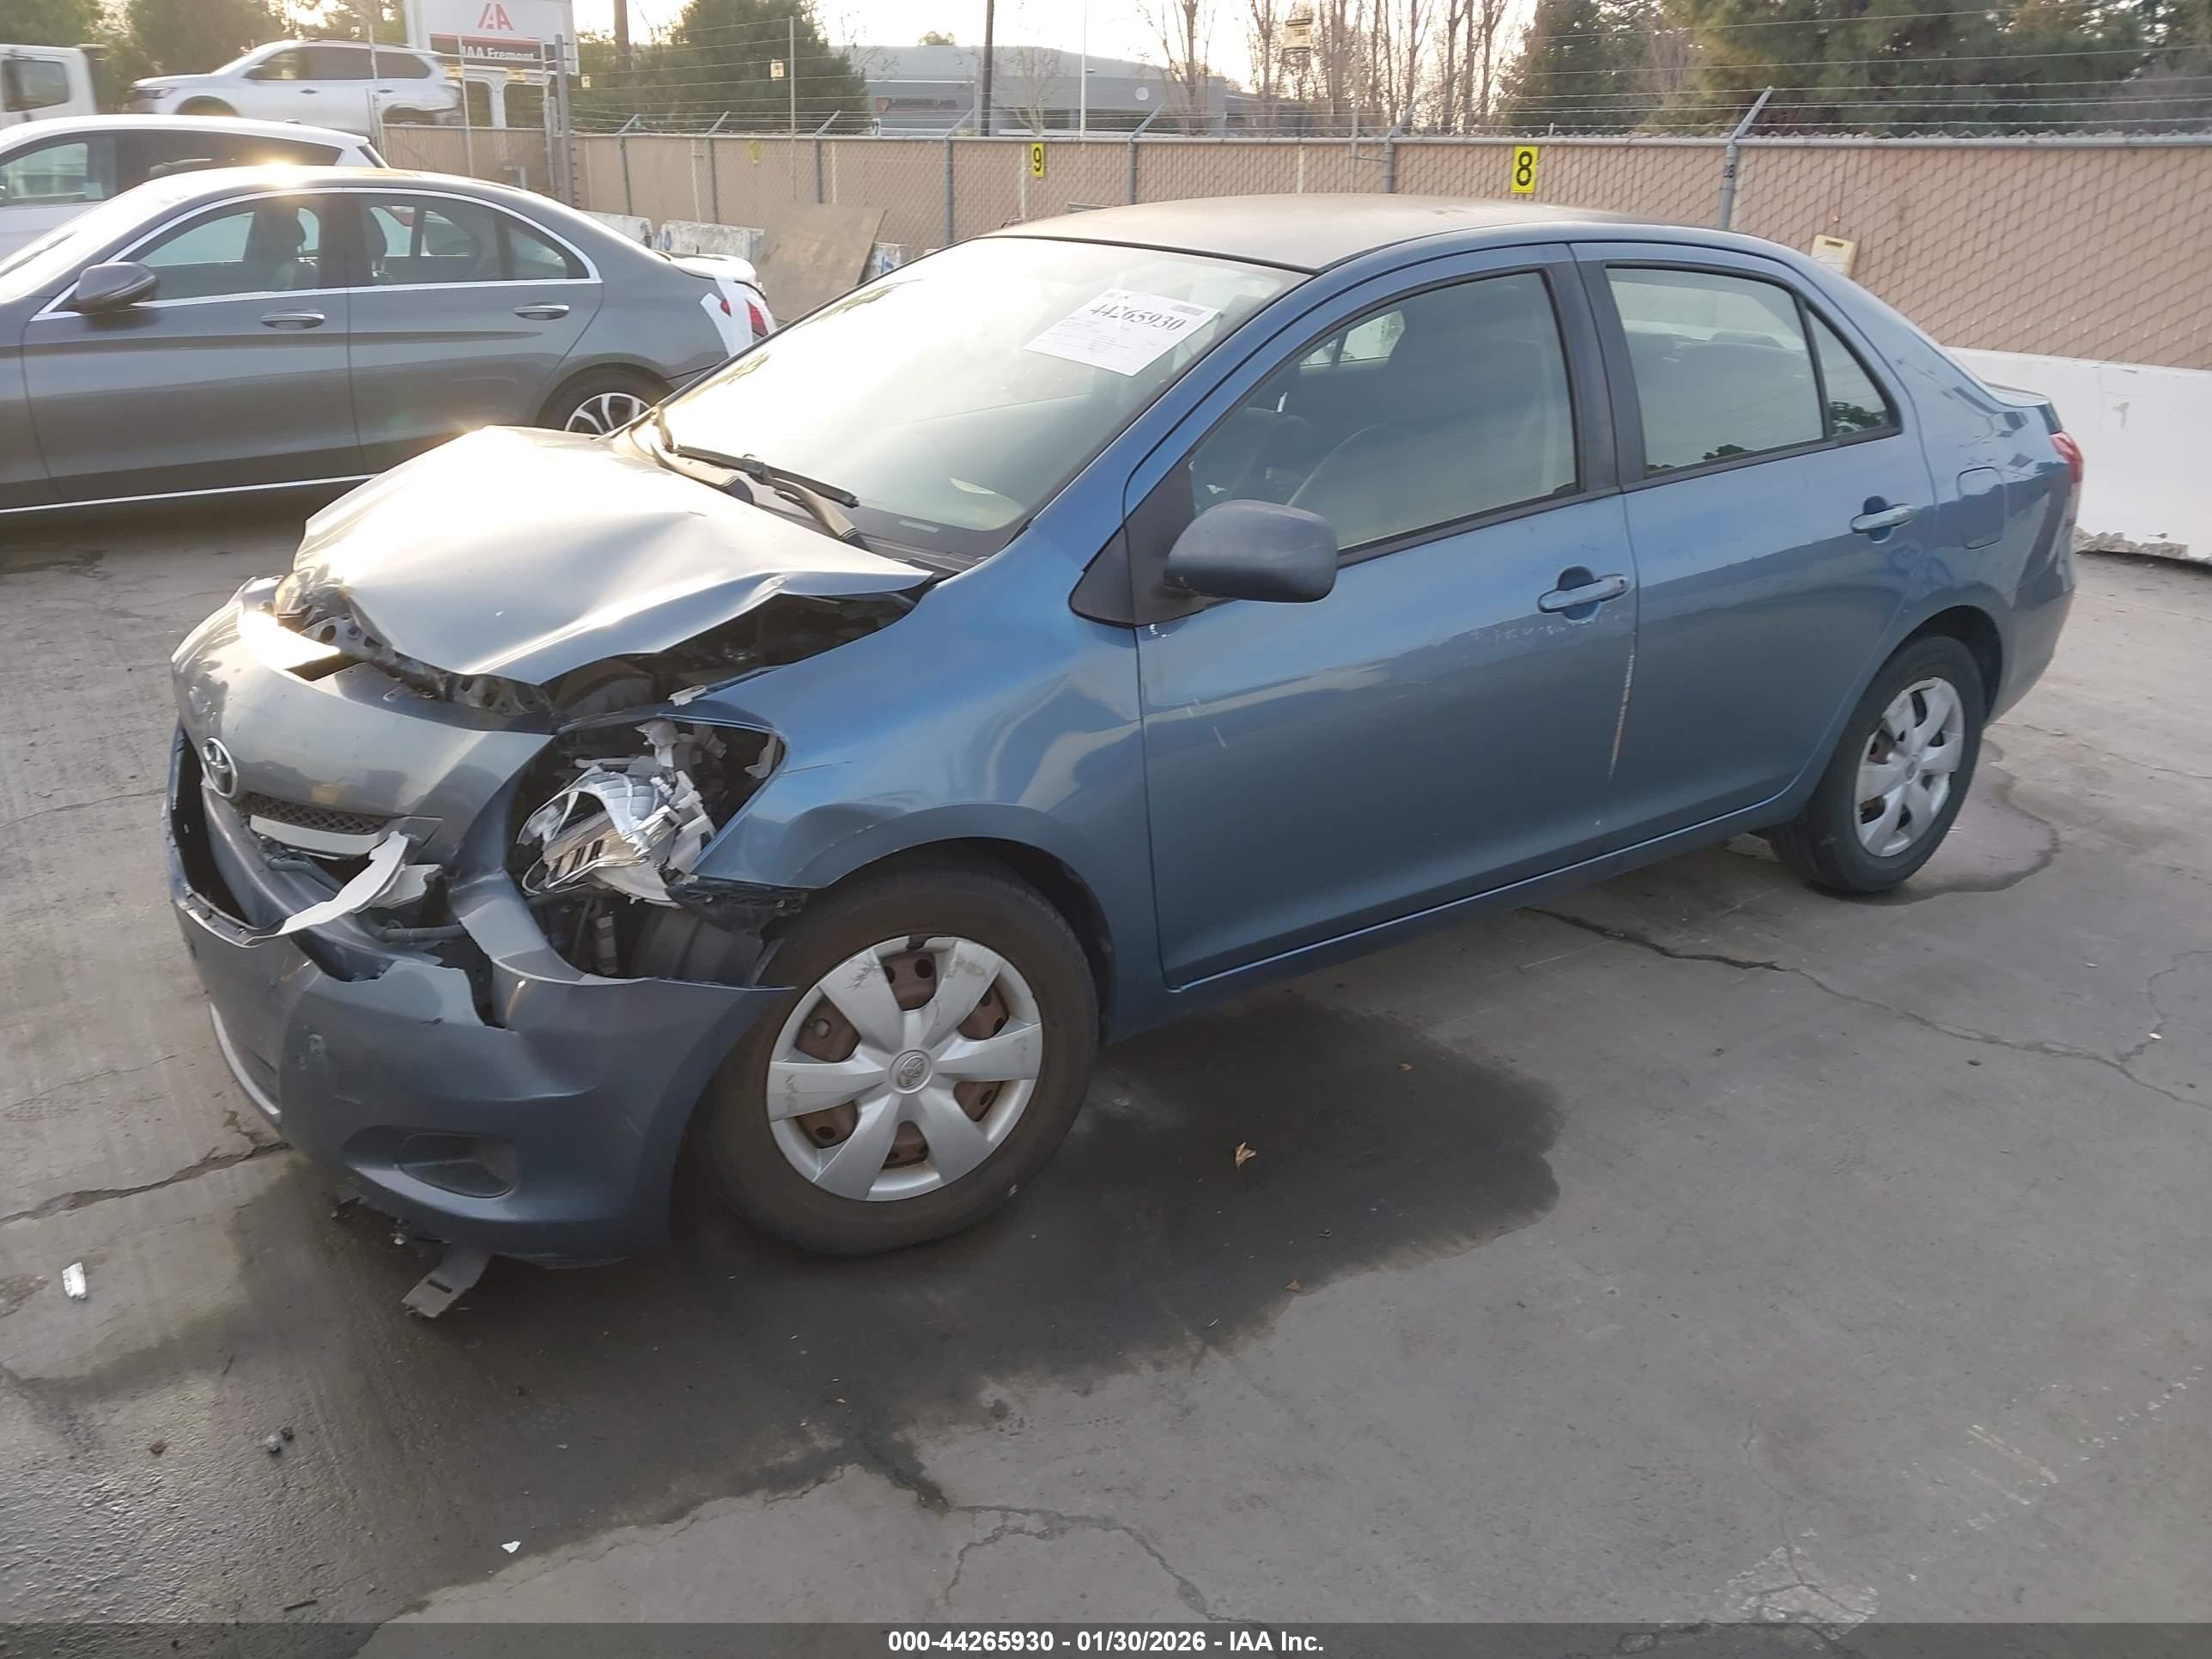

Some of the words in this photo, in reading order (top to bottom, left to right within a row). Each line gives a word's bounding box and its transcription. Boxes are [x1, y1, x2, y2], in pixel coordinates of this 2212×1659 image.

[487, 47, 534, 60] Fremont
[1033, 147, 1042, 172] 9
[1516, 150, 1533, 186] 8
[1090, 303, 1187, 331] 44265930
